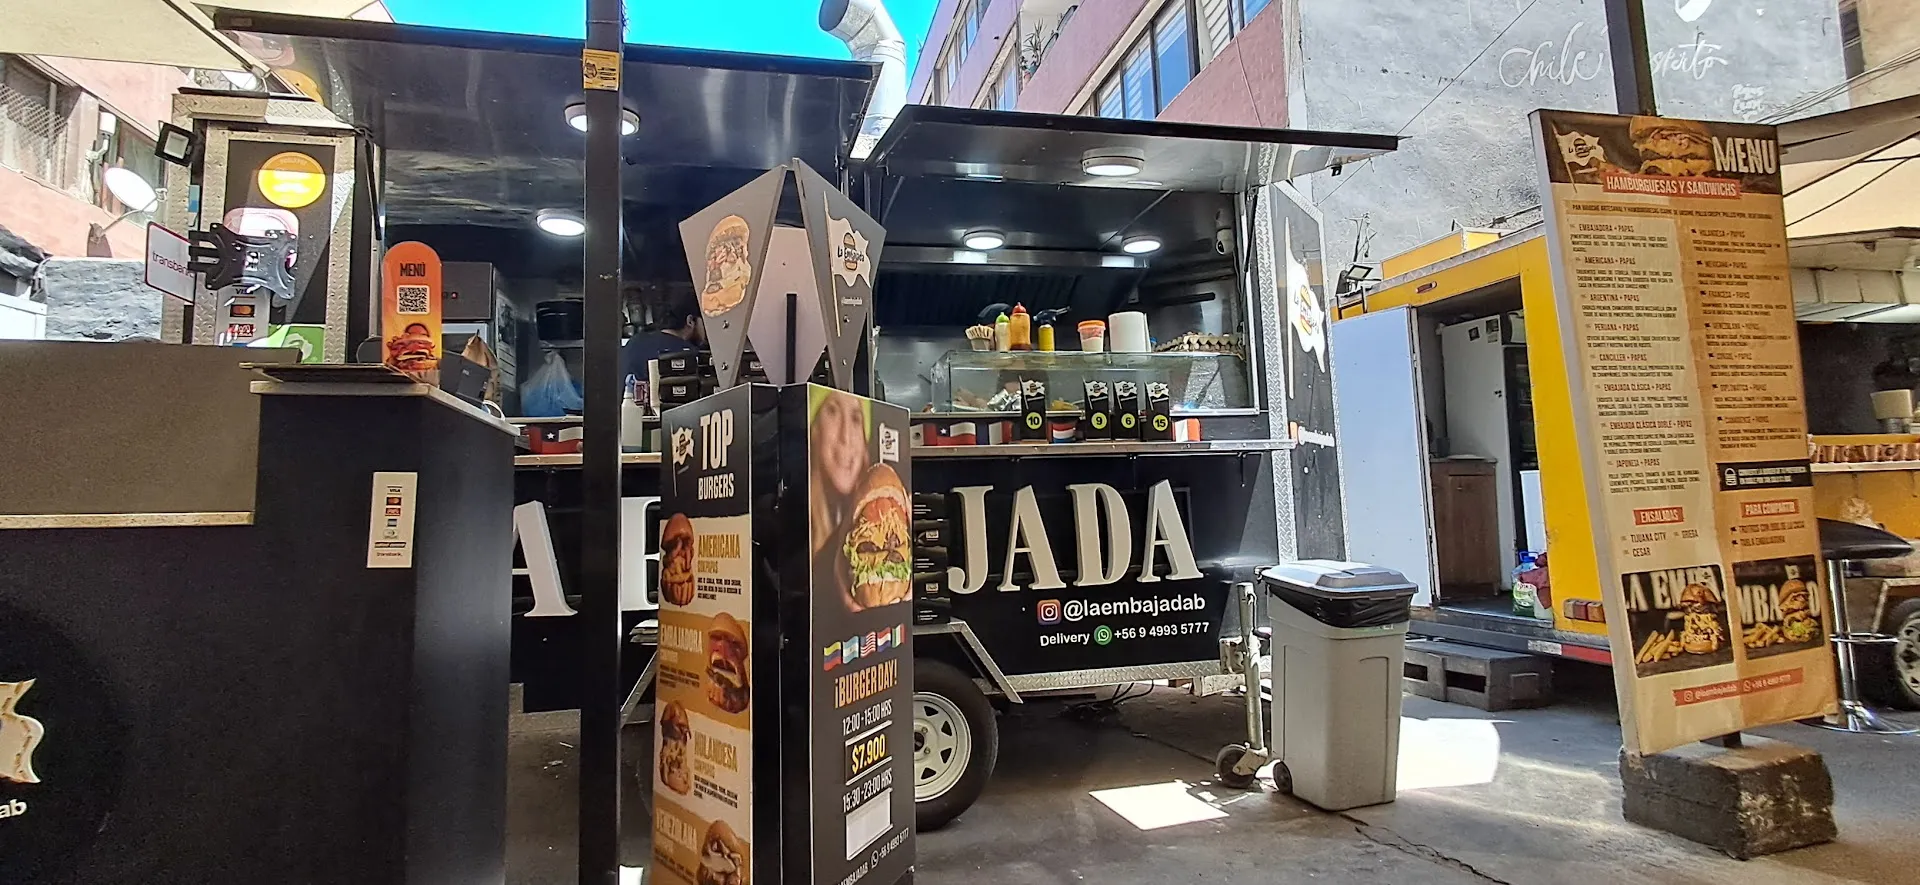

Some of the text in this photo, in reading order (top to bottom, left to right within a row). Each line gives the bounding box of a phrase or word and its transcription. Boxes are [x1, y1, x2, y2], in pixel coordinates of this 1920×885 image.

[1712, 136, 1777, 174] MENU
[1606, 176, 1736, 196] HAMBURGUESAS Y SANDWICHS
[400, 263, 426, 277] MENÚ
[1584, 256, 1614, 264] AMERICANA
[1028, 416, 1039, 425] 10
[1096, 416, 1102, 425] 9
[1125, 417, 1131, 425] 6
[1155, 419, 1166, 427] 15
[700, 409, 733, 471] TOP
[698, 472, 734, 500] BURGERS
[1640, 509, 1678, 523] ENSALADAS
[1745, 504, 1761, 515] PARA
[698, 534, 741, 558] AMERICANA
[1631, 532, 1666, 543] TIJUANA CITY
[512, 500, 578, 616] A
[1633, 547, 1651, 557] CESAR
[1064, 594, 1206, 622] @laembajadab
[1040, 622, 1210, 646] Delivery +56 9 4993 5777
[843, 712, 860, 736] 12:00
[881, 699, 892, 716] HRS
[694, 730, 738, 772] HOLANDESA
[852, 733, 886, 774] $7.900
[842, 792, 860, 813] 15:30
[881, 768, 892, 785] HRS
